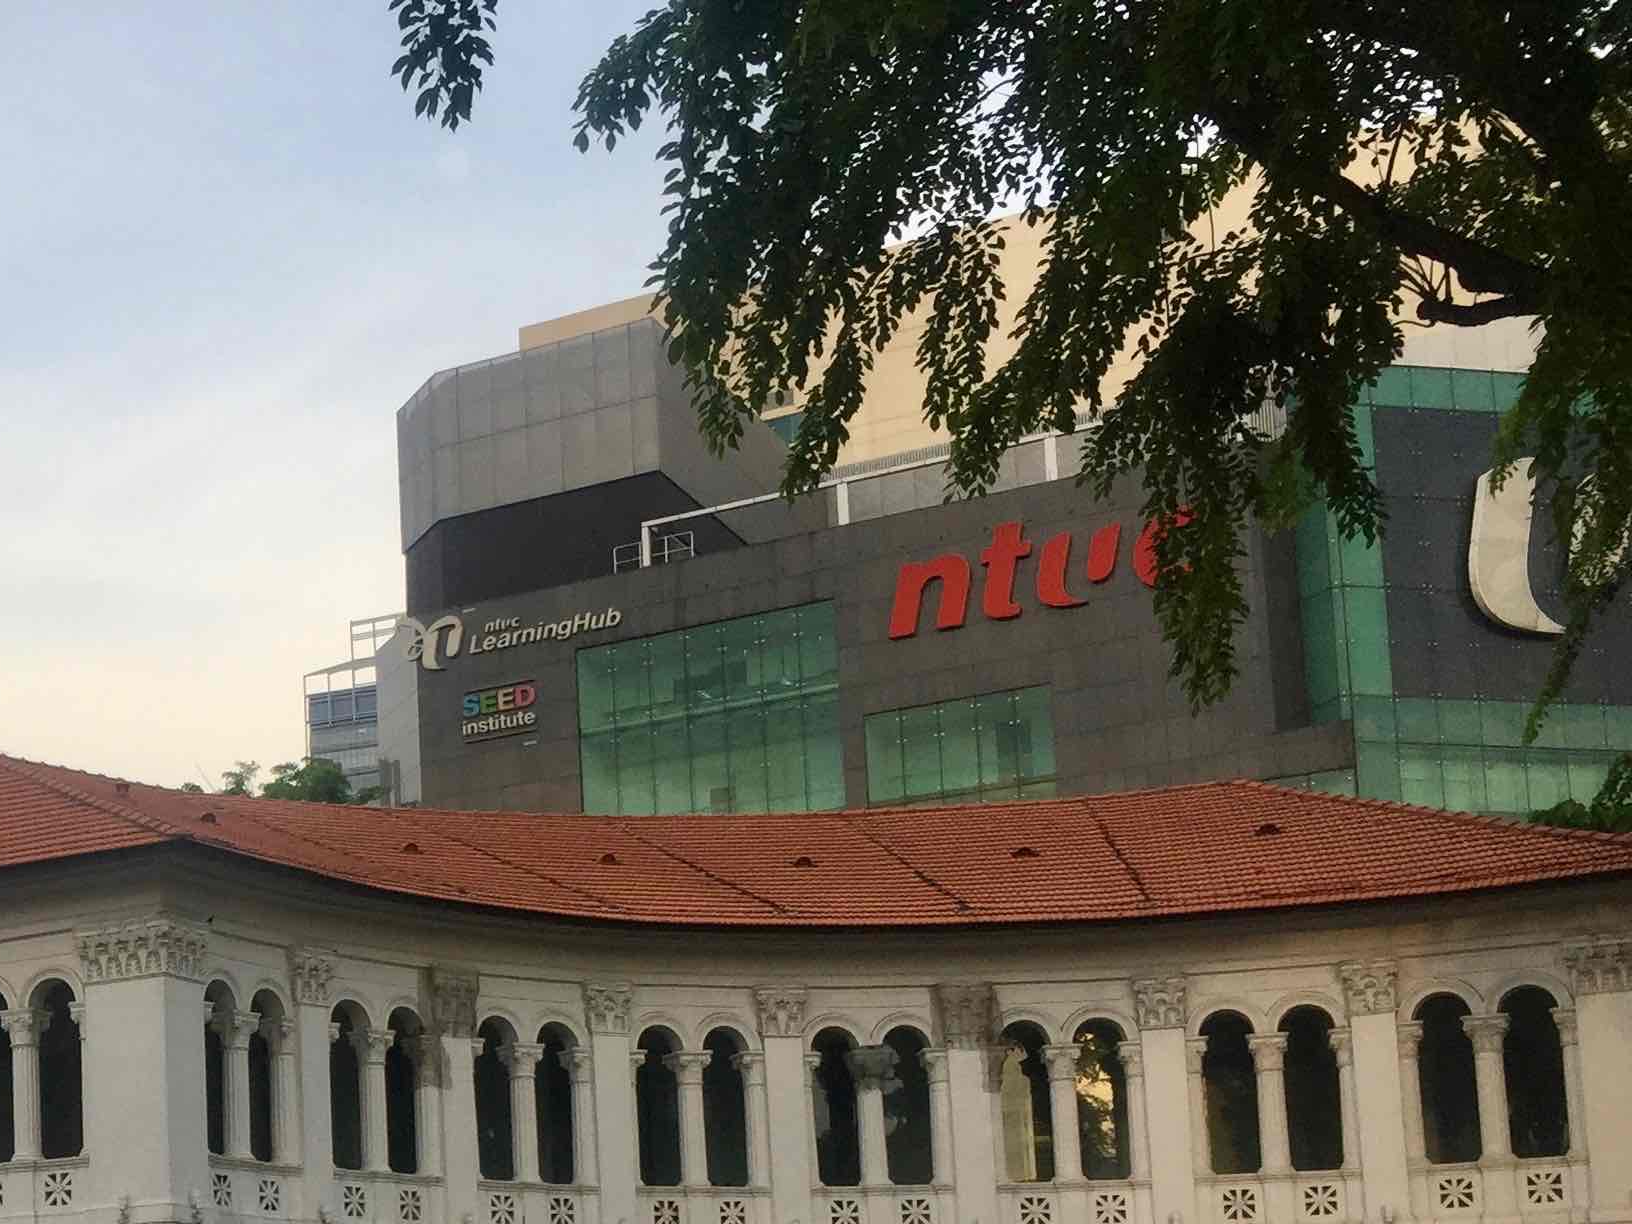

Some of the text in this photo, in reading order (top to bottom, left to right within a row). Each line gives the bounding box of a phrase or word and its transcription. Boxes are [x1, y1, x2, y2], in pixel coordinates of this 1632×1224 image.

[468, 606, 623, 655] LearningHub
[484, 615, 521, 633] ntuc
[464, 687, 536, 717] SEED
[462, 711, 536, 736] institute
